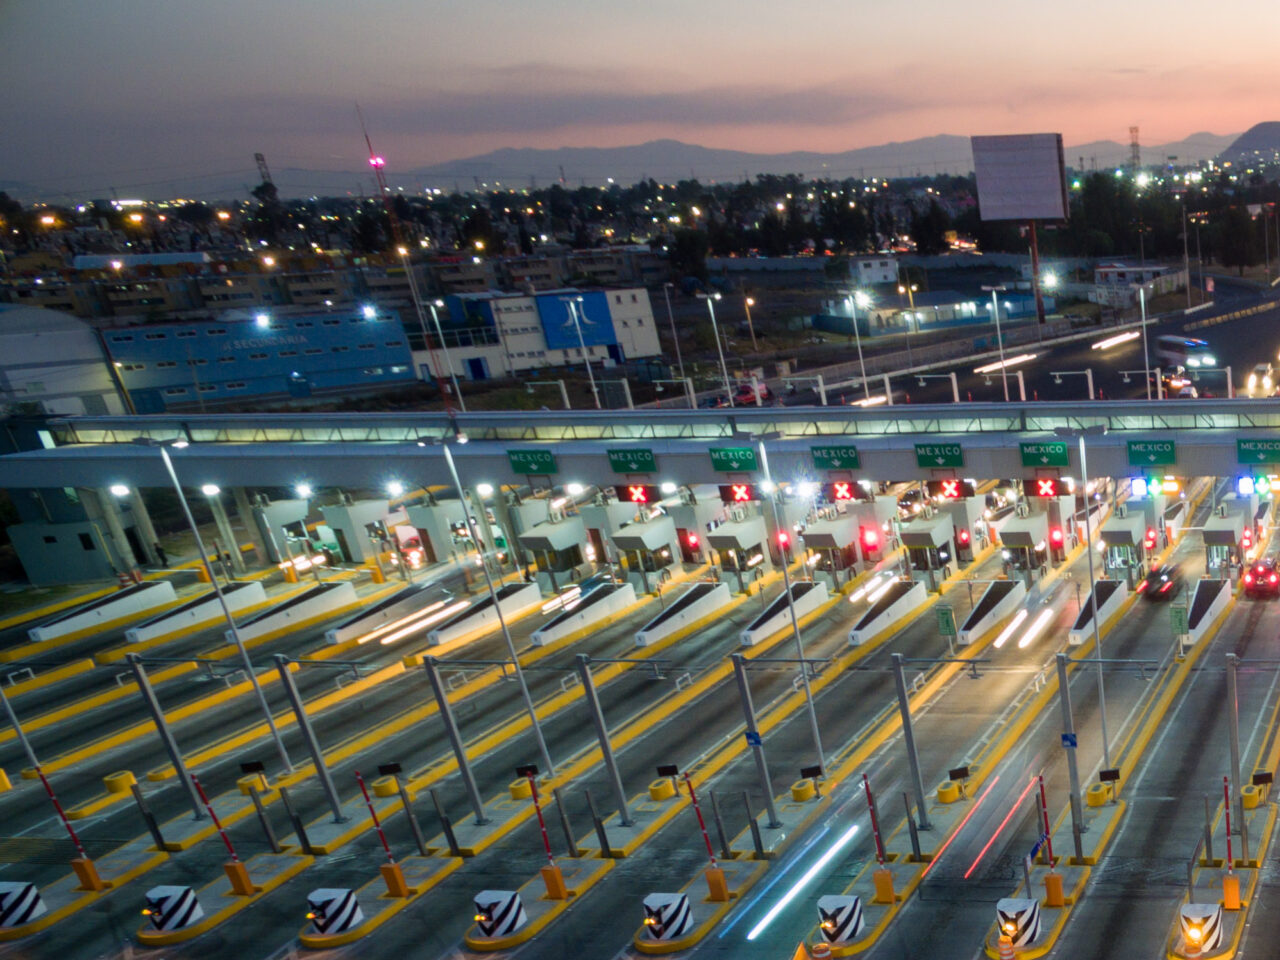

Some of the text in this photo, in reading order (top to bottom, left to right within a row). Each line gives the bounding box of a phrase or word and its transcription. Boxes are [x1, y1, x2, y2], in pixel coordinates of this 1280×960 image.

[917, 446, 960, 456] MEXICO
[1023, 445, 1063, 454] MEXICO
[1131, 443, 1171, 452] MEXICO
[511, 453, 551, 463] MEXICO
[610, 452, 651, 462] MEXICO
[711, 451, 753, 461] MEXICO
[813, 449, 856, 459] MEXICO
